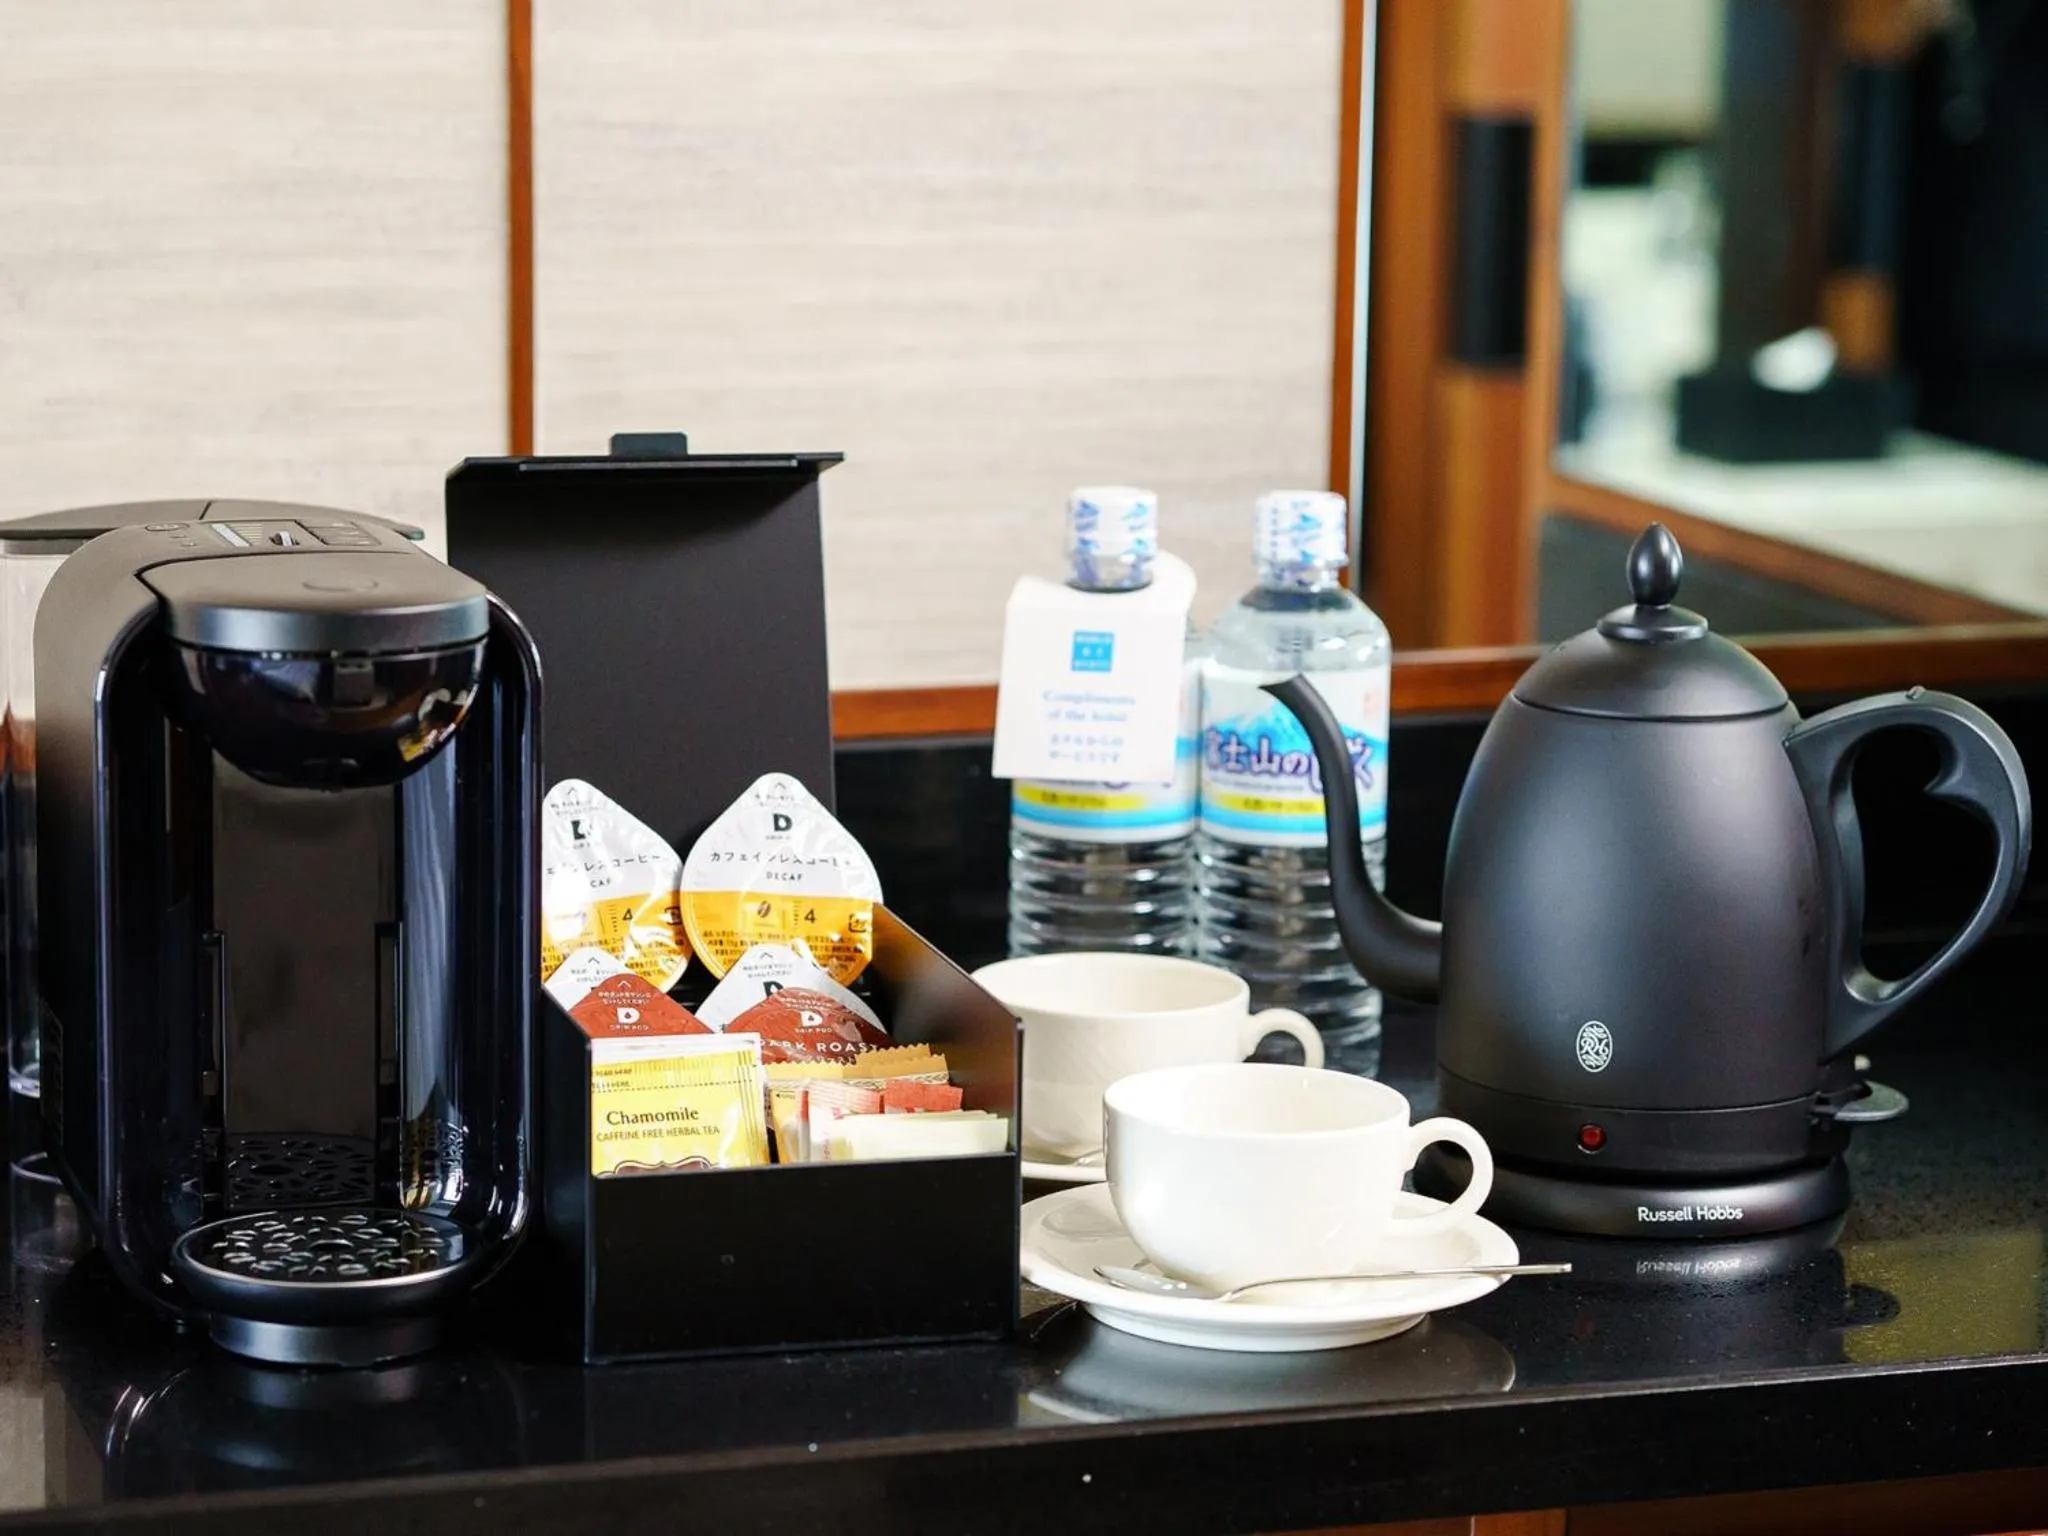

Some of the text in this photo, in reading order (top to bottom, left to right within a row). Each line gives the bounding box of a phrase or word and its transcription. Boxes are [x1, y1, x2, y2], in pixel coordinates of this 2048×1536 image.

[804, 909, 816, 924] 4
[606, 1107, 699, 1125] Chamomile
[596, 1125, 721, 1142] CAFFEINE FREE HERBAL TEA
[1637, 1205, 1744, 1222] Russell Hobbs
